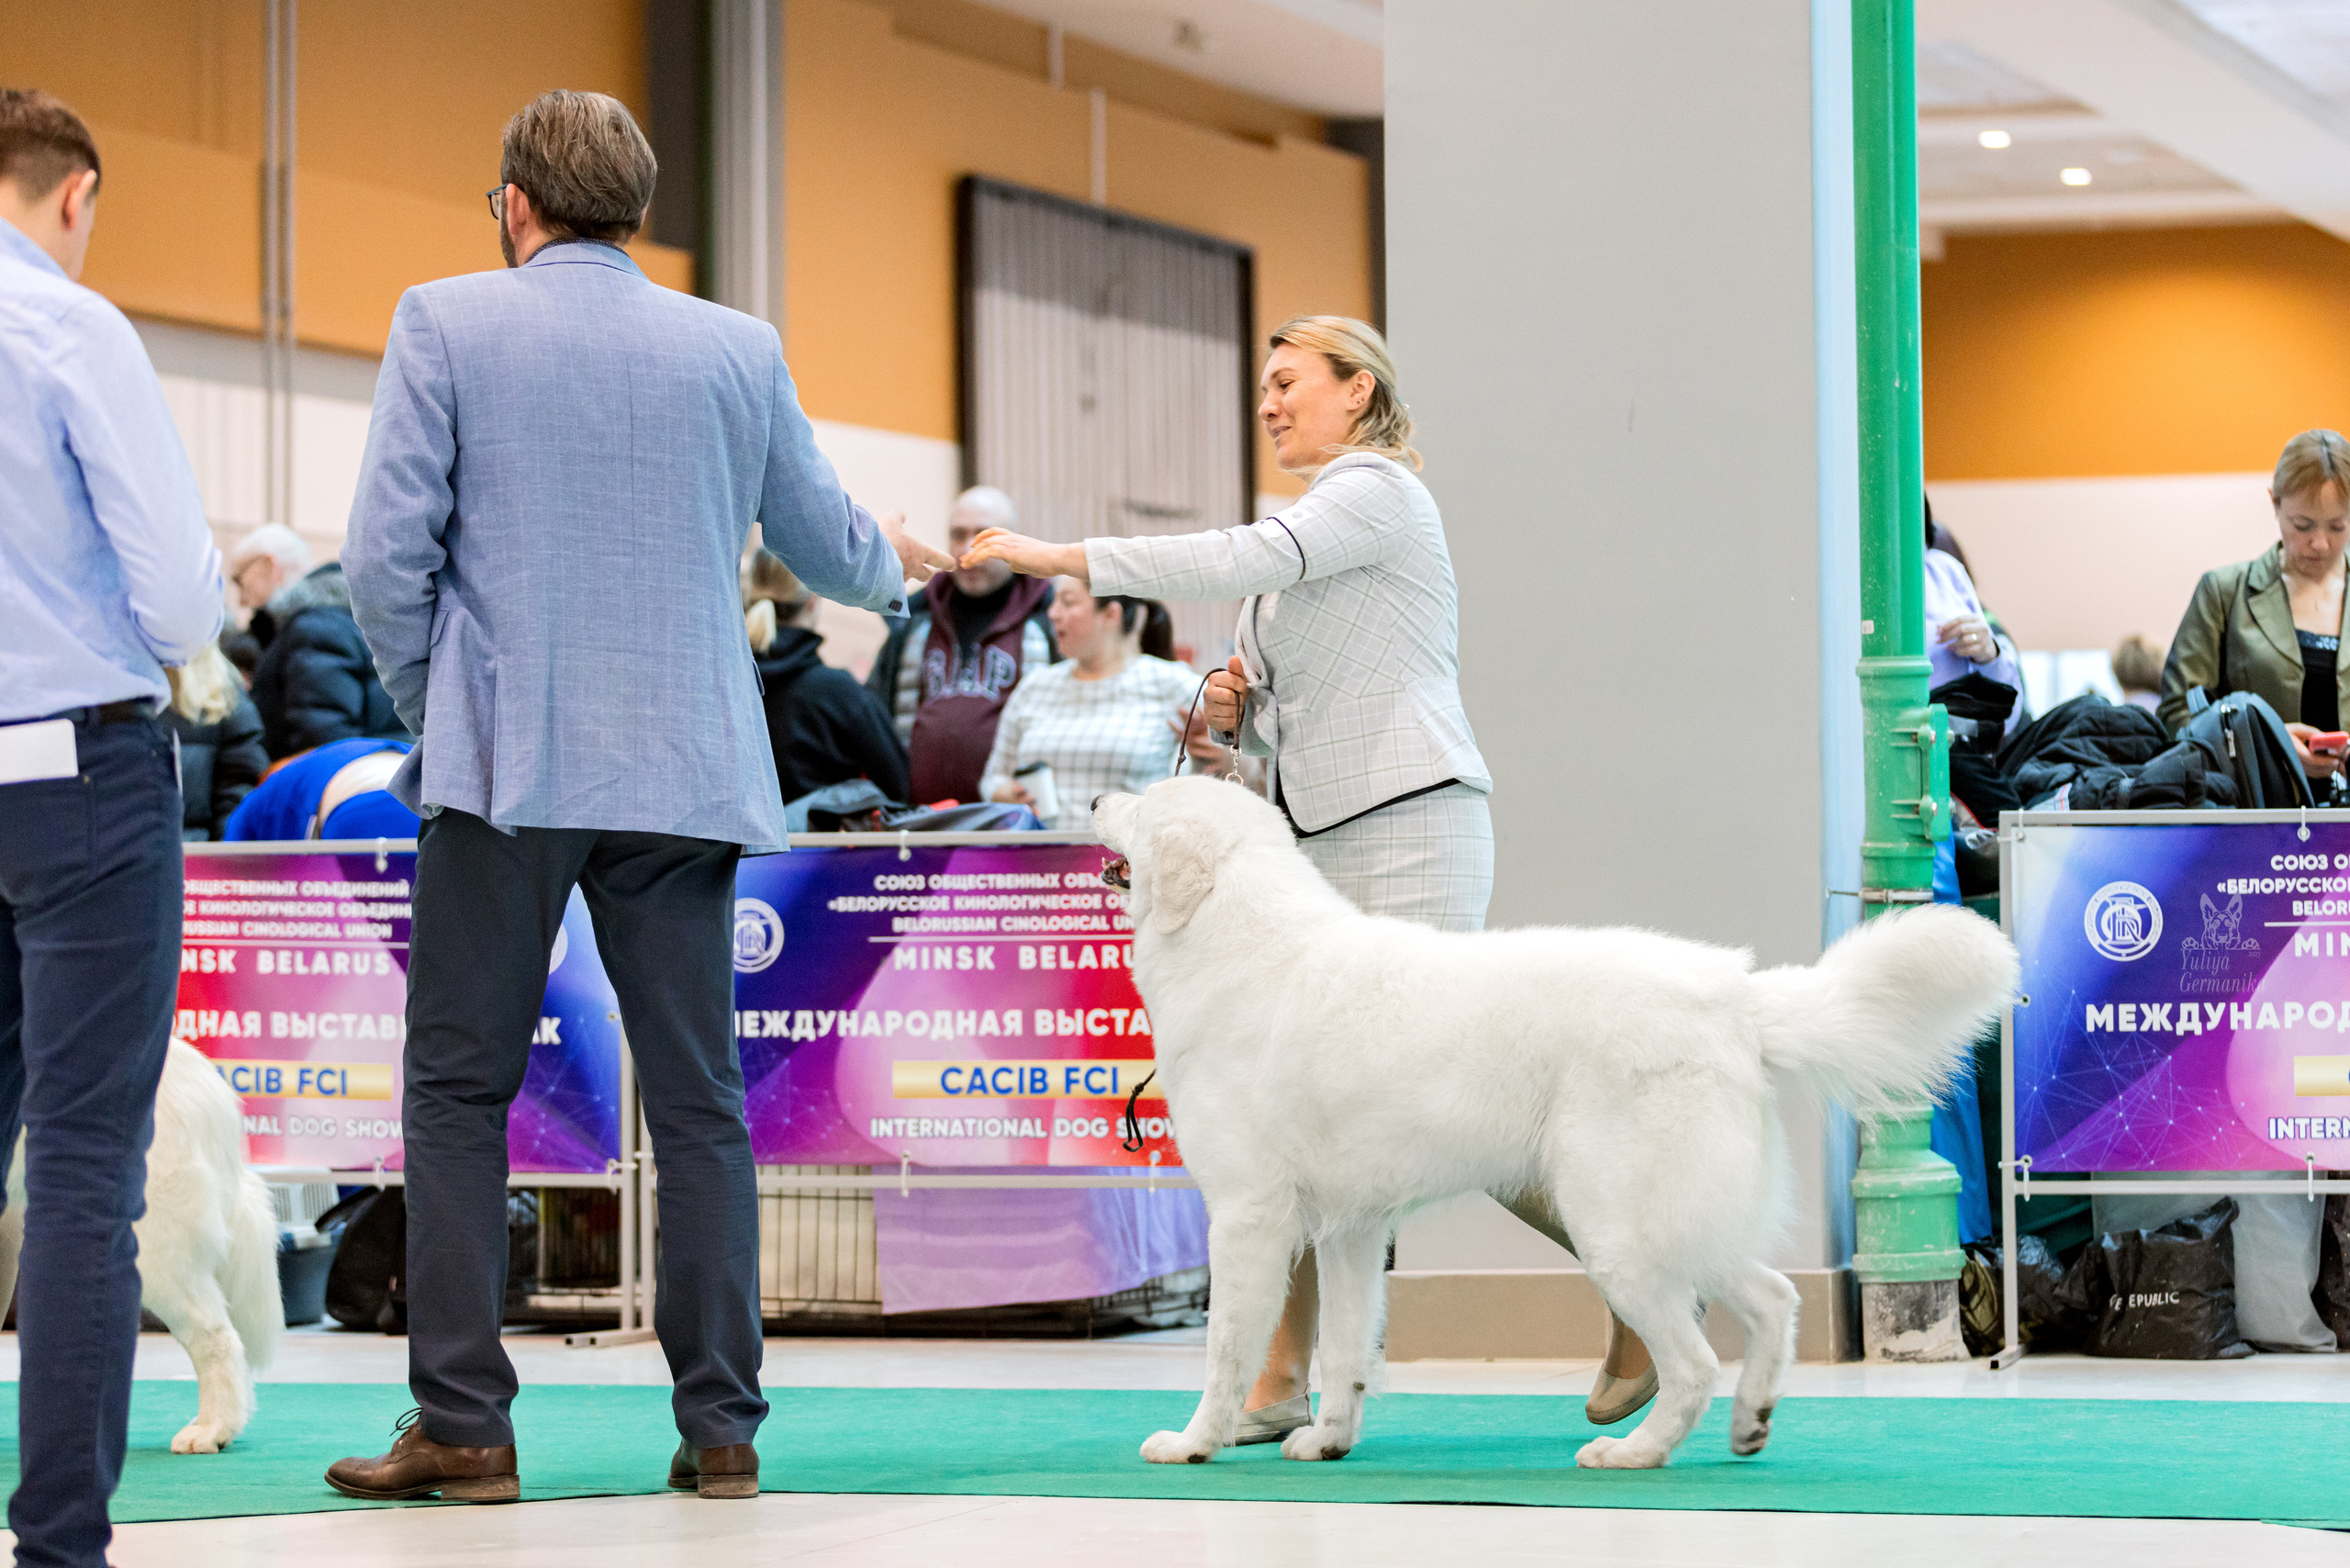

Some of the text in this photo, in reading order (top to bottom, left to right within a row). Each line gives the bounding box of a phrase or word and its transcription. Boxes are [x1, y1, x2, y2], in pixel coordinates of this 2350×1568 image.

[2270, 853, 2329, 871] СОЮЗ
[874, 873, 926, 891] СОЮЗ
[928, 872, 1061, 891] ОБЩЕСТВЕННЫХ
[2217, 876, 2350, 895] «БЕЛОРУССКО
[953, 893, 1102, 911] КИНОЛОГИЧЕСКОЕ
[241, 921, 342, 938] CINOLOGICAL
[343, 923, 393, 939] UNION
[891, 915, 998, 933] BELORUSSIAN
[1000, 913, 1111, 932] CINOLOGICAL
[256, 949, 392, 976] BELARUS
[893, 945, 996, 971] MINSK
[270, 1010, 407, 1042] ВЫСТАВ
[734, 1009, 1024, 1042] ЕЖДУНАРОДНАЯ
[297, 1067, 348, 1097] FCI
[940, 1066, 1119, 1095] CACIB FCI
[287, 1114, 339, 1138] DOG
[870, 1116, 1049, 1139] INTERNATIONAL
[1055, 1116, 1110, 1139] DOG
